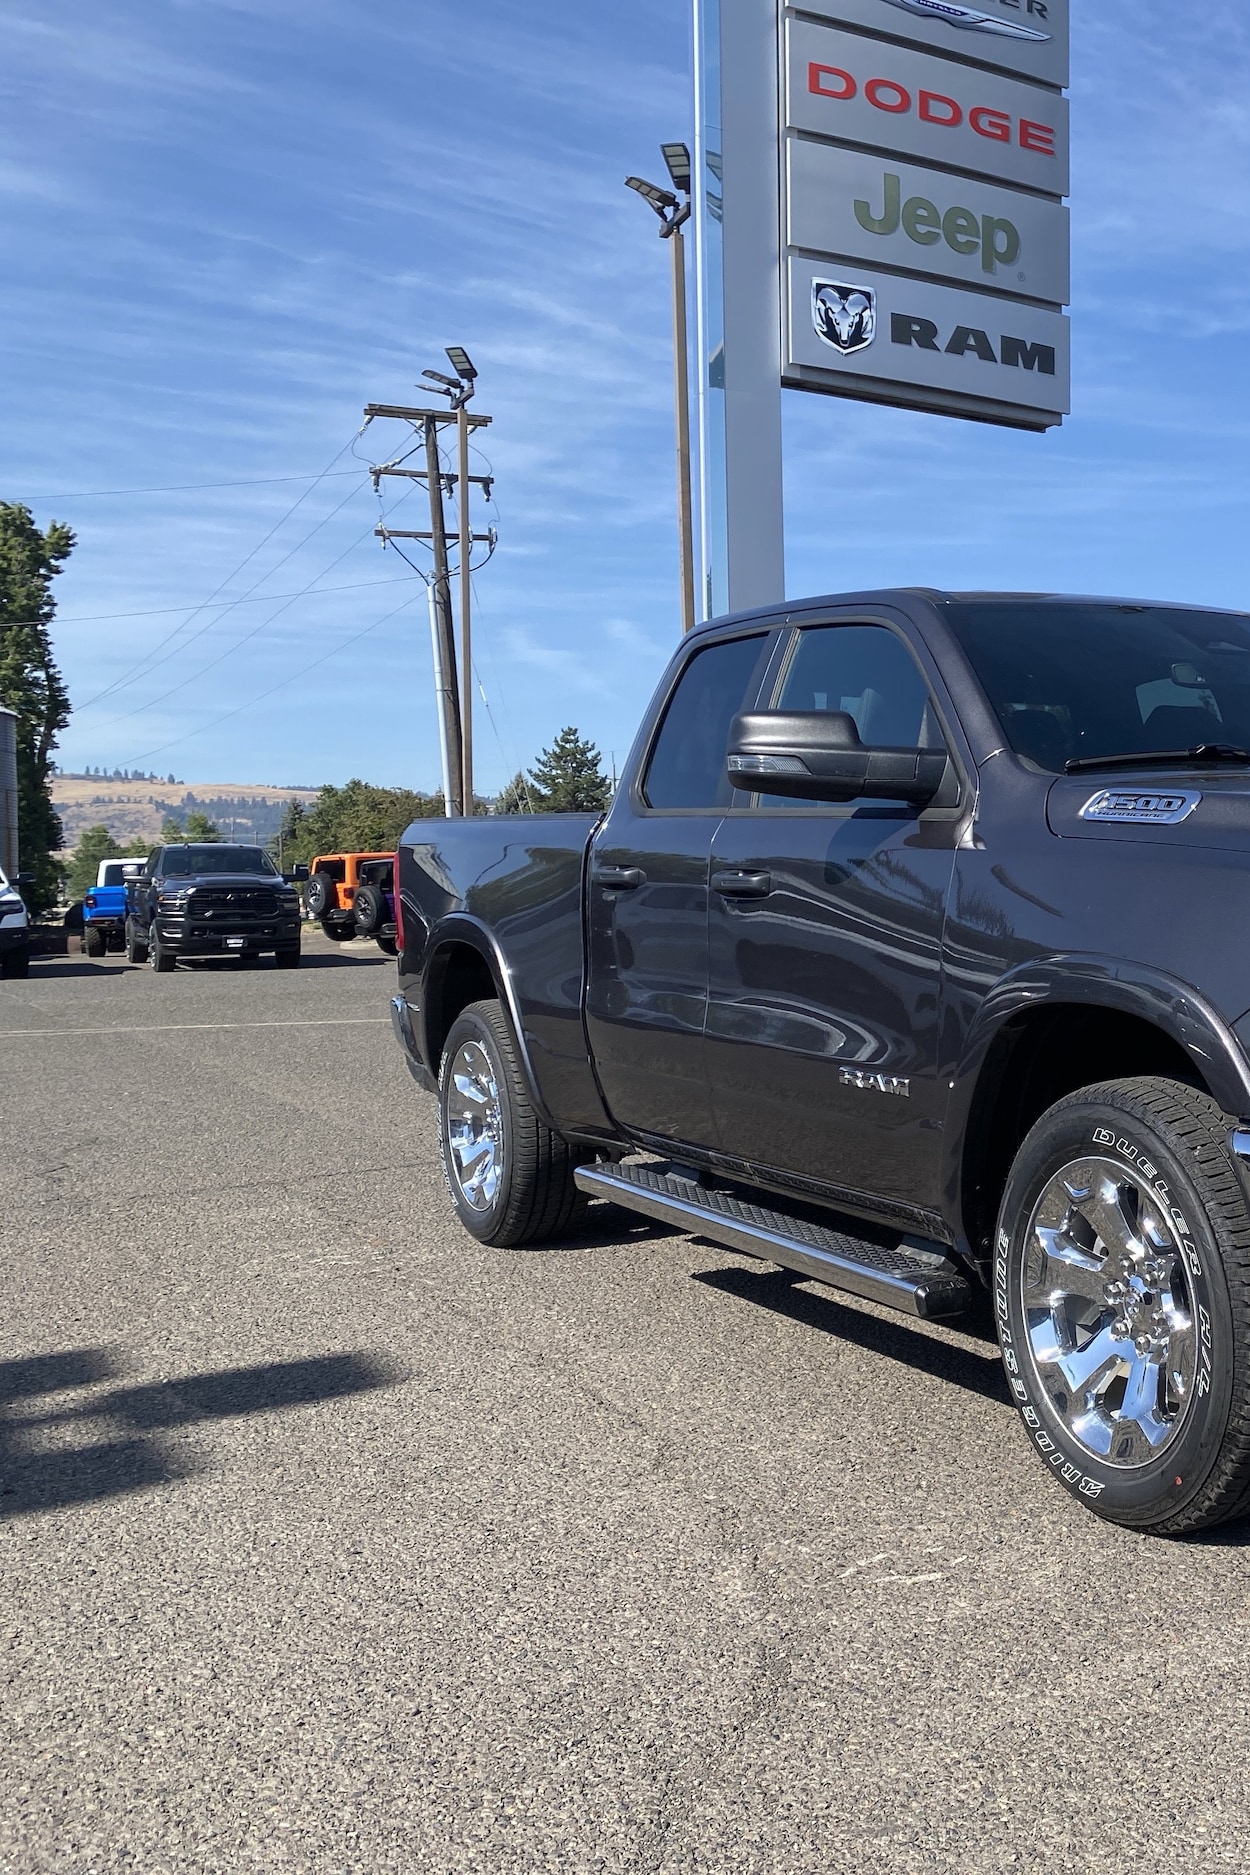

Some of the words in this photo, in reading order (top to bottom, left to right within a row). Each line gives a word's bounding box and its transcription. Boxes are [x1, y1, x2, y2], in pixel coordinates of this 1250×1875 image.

[808, 62, 1055, 156] DODGE
[853, 172, 1019, 272] Jeep
[890, 312, 1055, 375] RAM
[1103, 795, 1183, 811] 1500
[839, 1066, 910, 1097] RAM
[1092, 1127, 1202, 1276] DUELER
[996, 1226, 1106, 1499] BRIDGESTONE
